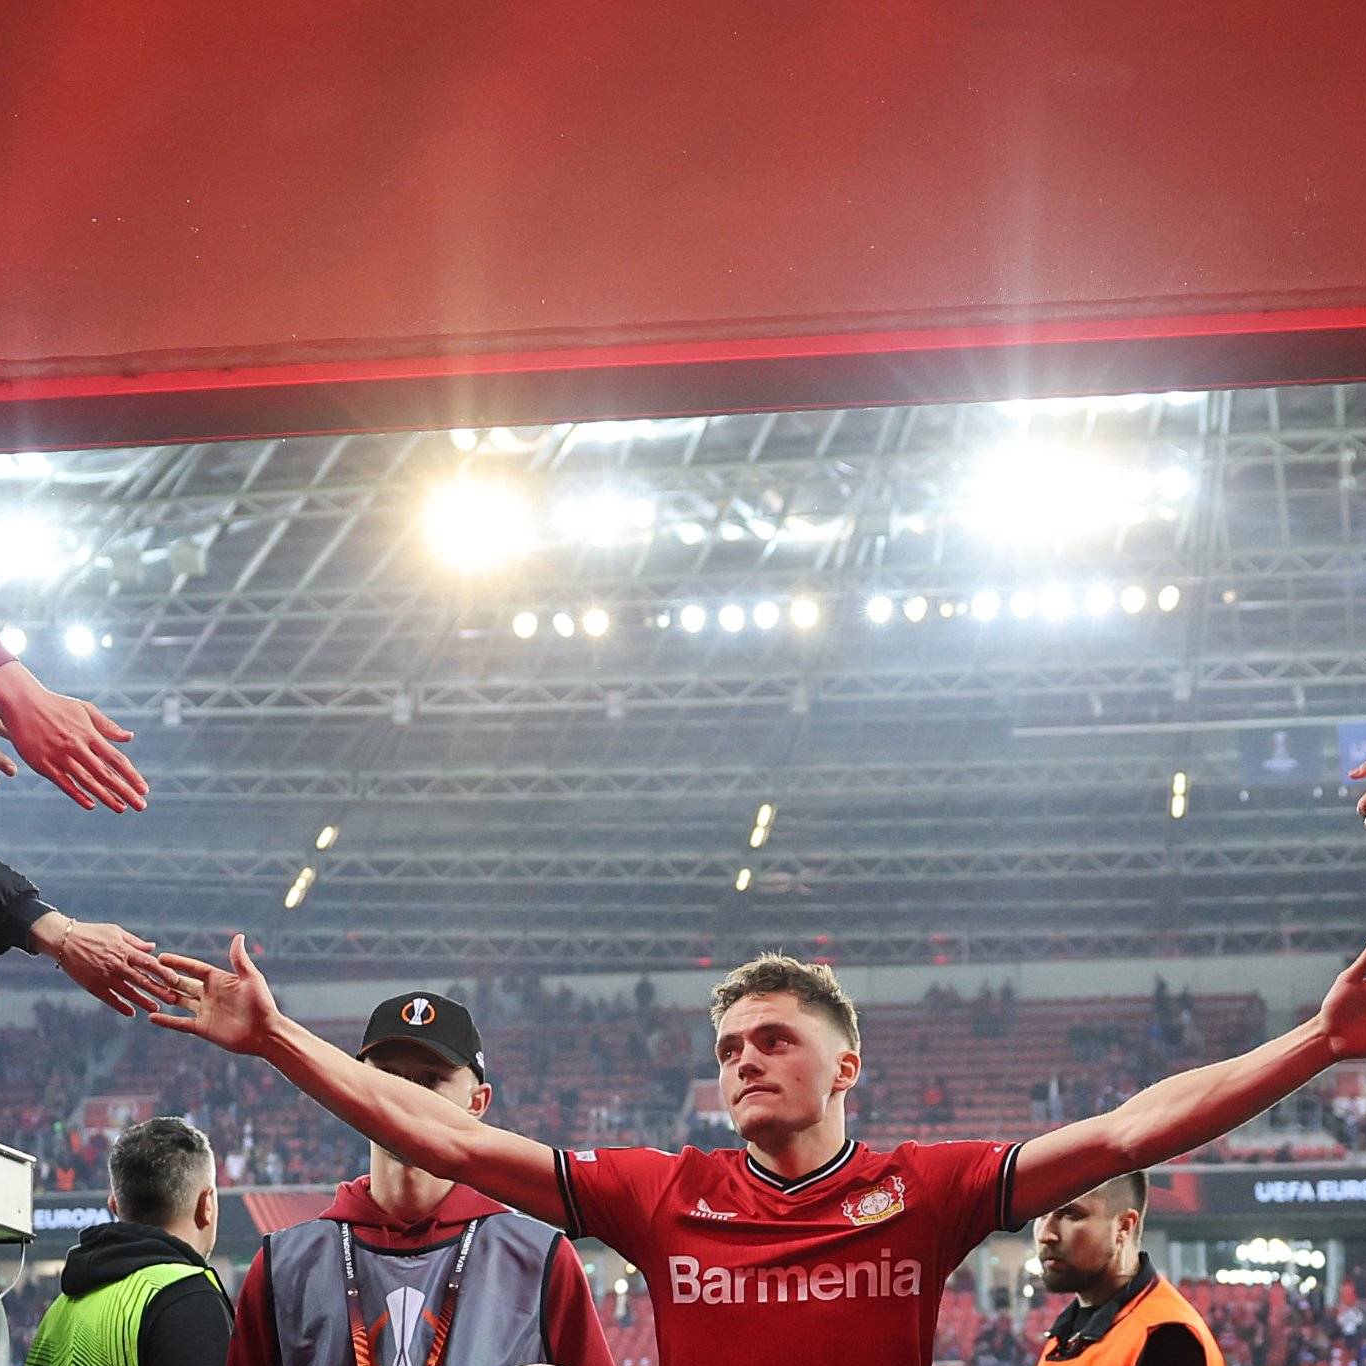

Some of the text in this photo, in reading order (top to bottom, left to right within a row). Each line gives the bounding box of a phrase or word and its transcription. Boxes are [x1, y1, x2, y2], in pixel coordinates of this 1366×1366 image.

[1254, 1180, 1315, 1202] UEFA
[345, 1261, 354, 1279] UEFA
[455, 1256, 466, 1273] UEFA
[668, 1248, 922, 1305] Barmenia
